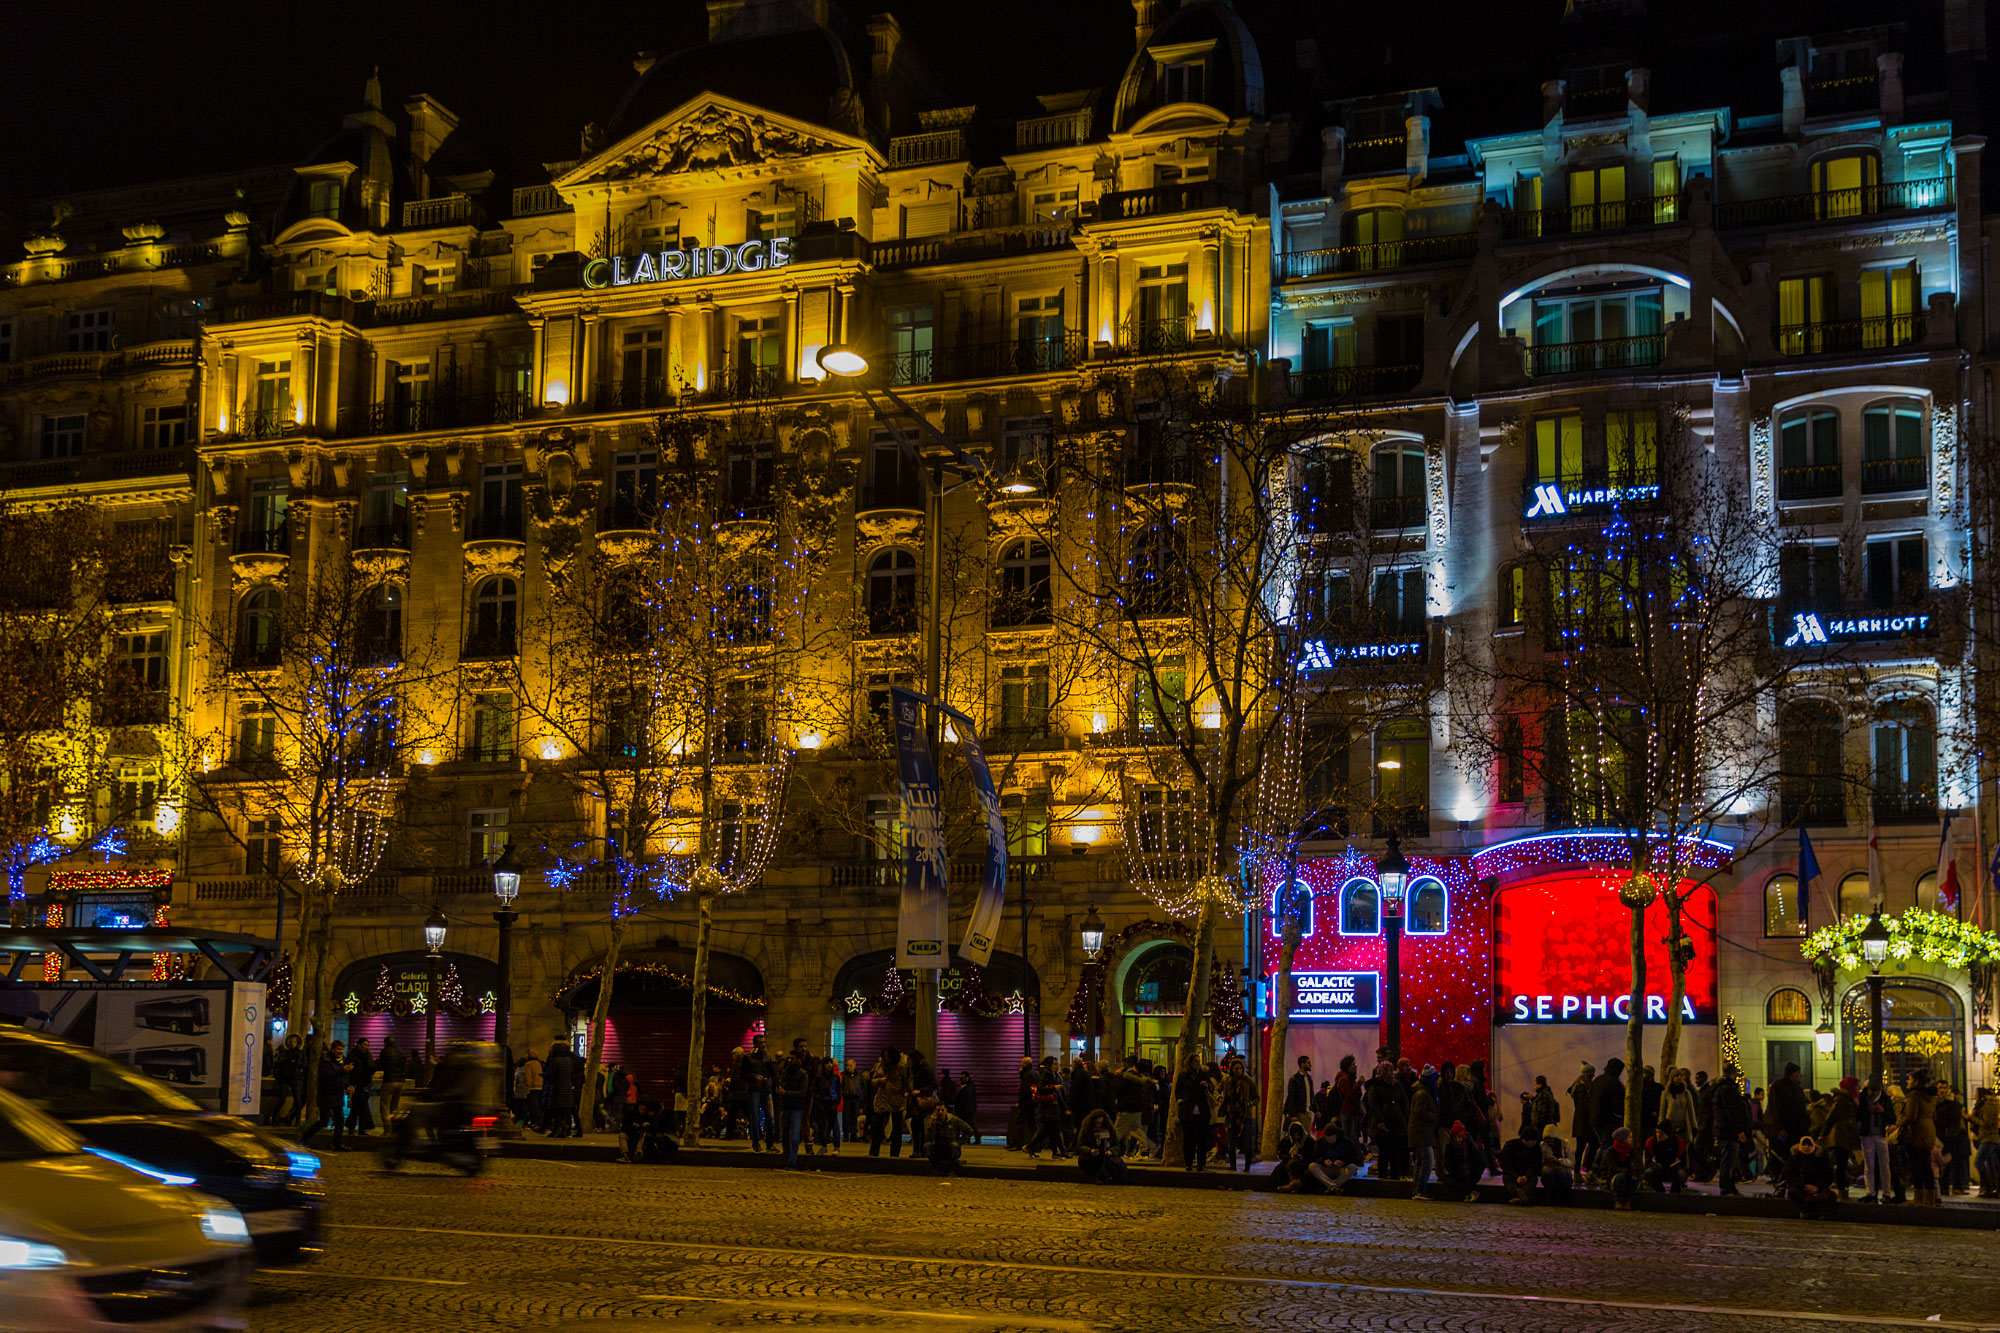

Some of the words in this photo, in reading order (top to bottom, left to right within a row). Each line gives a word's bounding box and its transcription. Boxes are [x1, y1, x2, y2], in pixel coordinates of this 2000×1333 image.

[583, 237, 790, 289] CLARIDGE
[1568, 484, 1661, 505] MARRIOTT
[1830, 615, 1929, 634] MARRIOTT
[1334, 642, 1420, 660] MARRIOTT
[1297, 976, 1355, 988] GALACTIC
[1297, 992, 1355, 1004] CADEAUX
[1514, 994, 1696, 1020] SEPHORA
